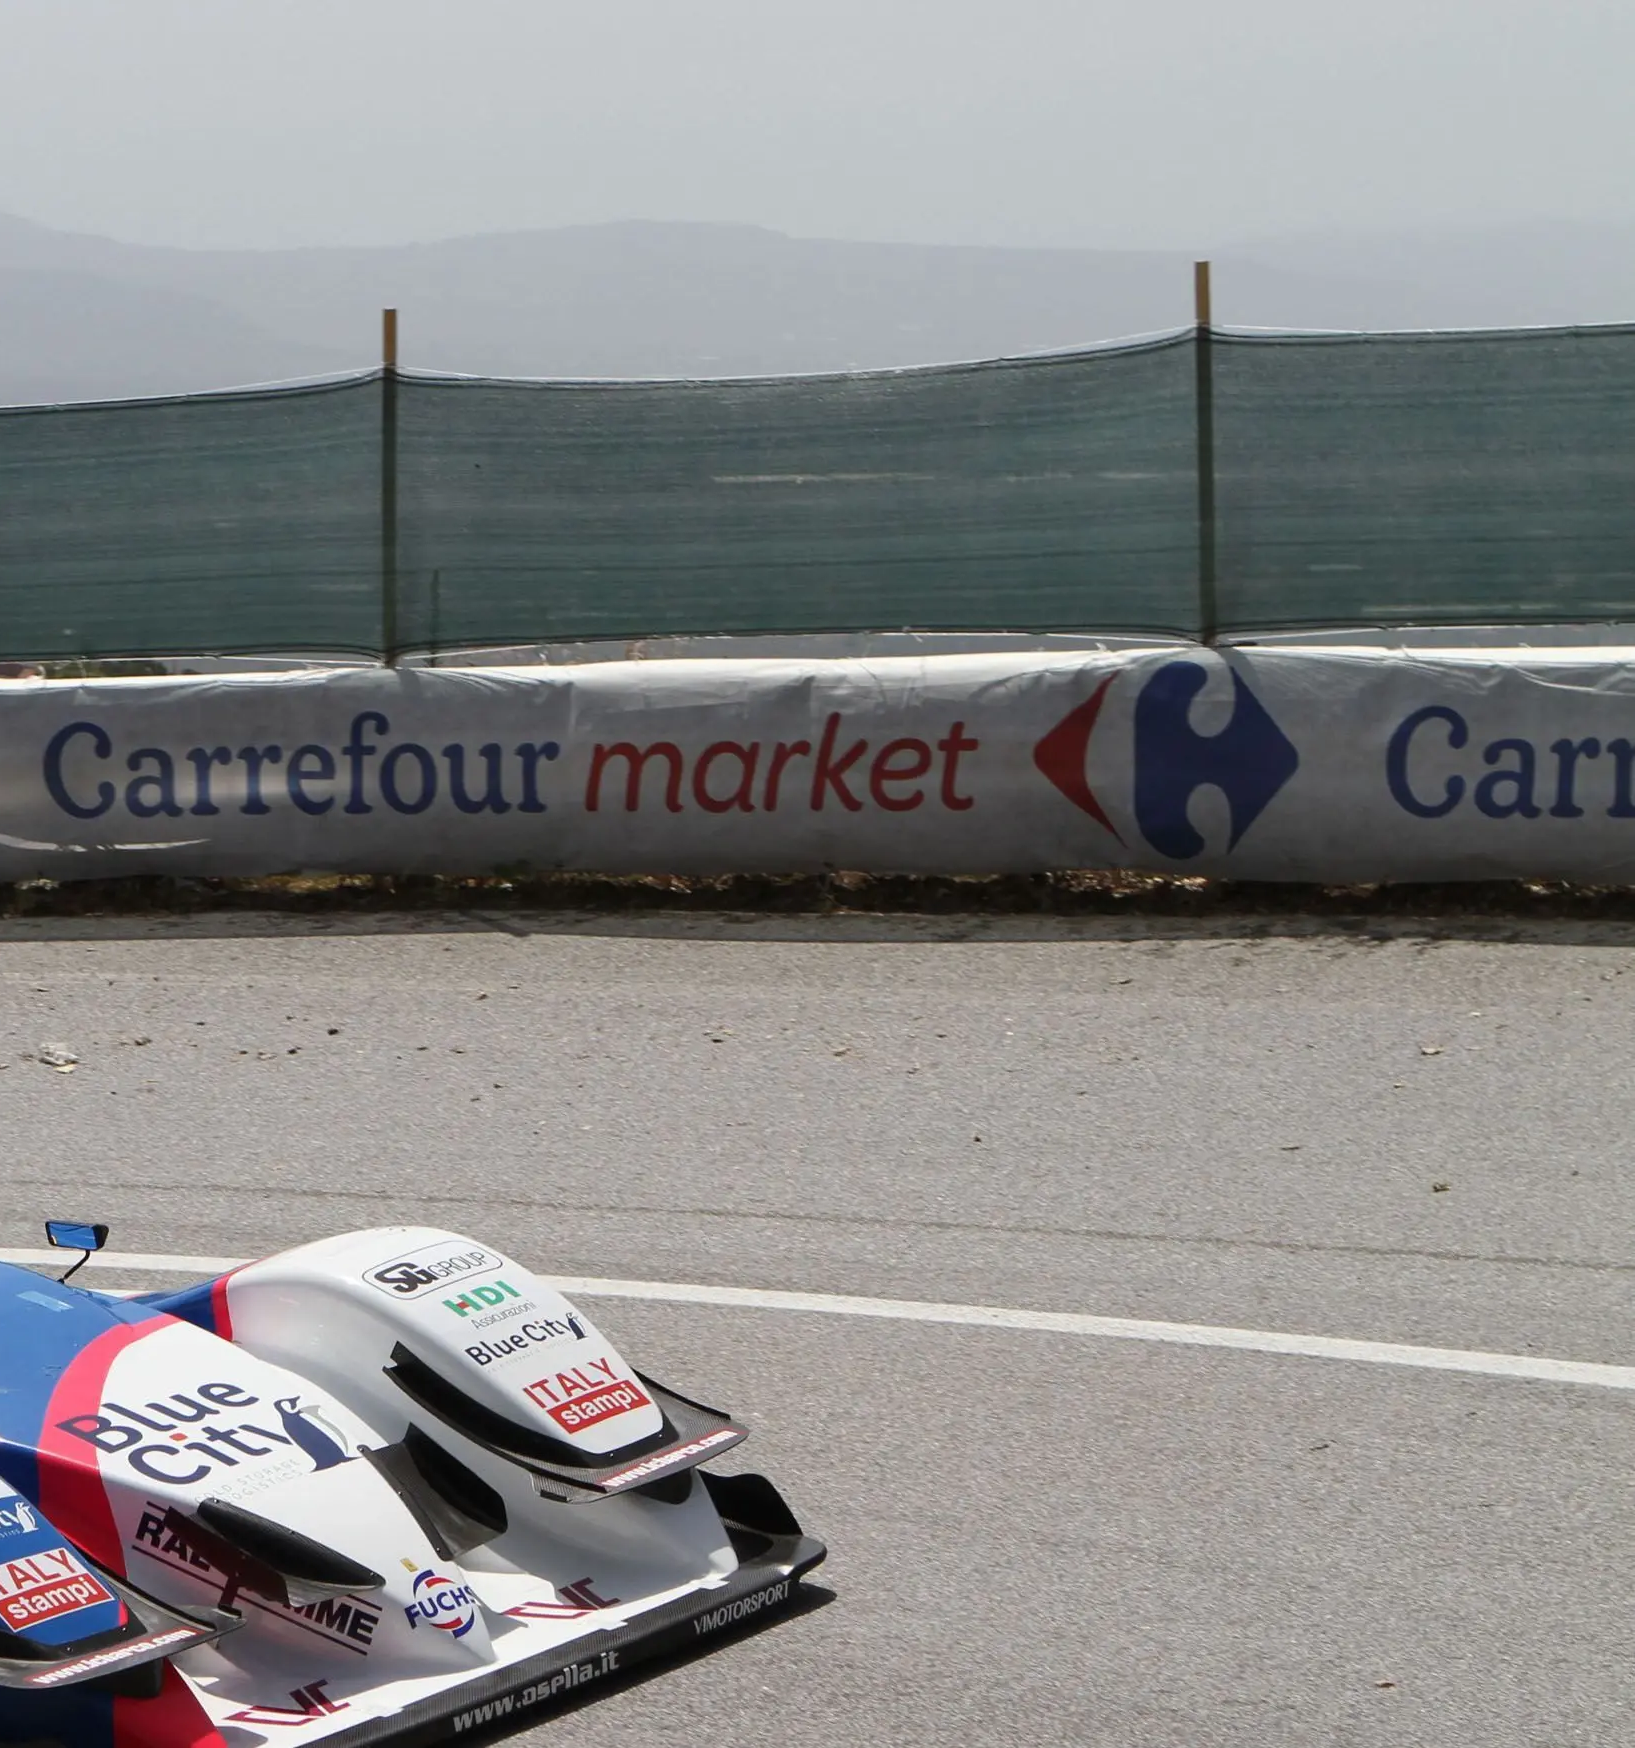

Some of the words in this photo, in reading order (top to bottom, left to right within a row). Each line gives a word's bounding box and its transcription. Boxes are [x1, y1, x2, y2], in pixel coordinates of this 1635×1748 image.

[43, 711, 561, 821] Carrefour
[584, 712, 979, 813] market
[1385, 705, 1635, 820] Carr
[429, 1251, 486, 1279] GROUP
[442, 1280, 522, 1318] HDI
[470, 1299, 539, 1330] Assicurazioni
[464, 1332, 529, 1366] Blue
[521, 1319, 572, 1343] City
[522, 1357, 619, 1409] ITALY
[559, 1384, 641, 1426] stampi
[54, 1383, 260, 1454] Blue
[127, 1424, 294, 1485] City
[230, 1470, 304, 1501] OGISTICS
[7, 1577, 98, 1620] stampi
[453, 1650, 620, 1733] www.osella.it
